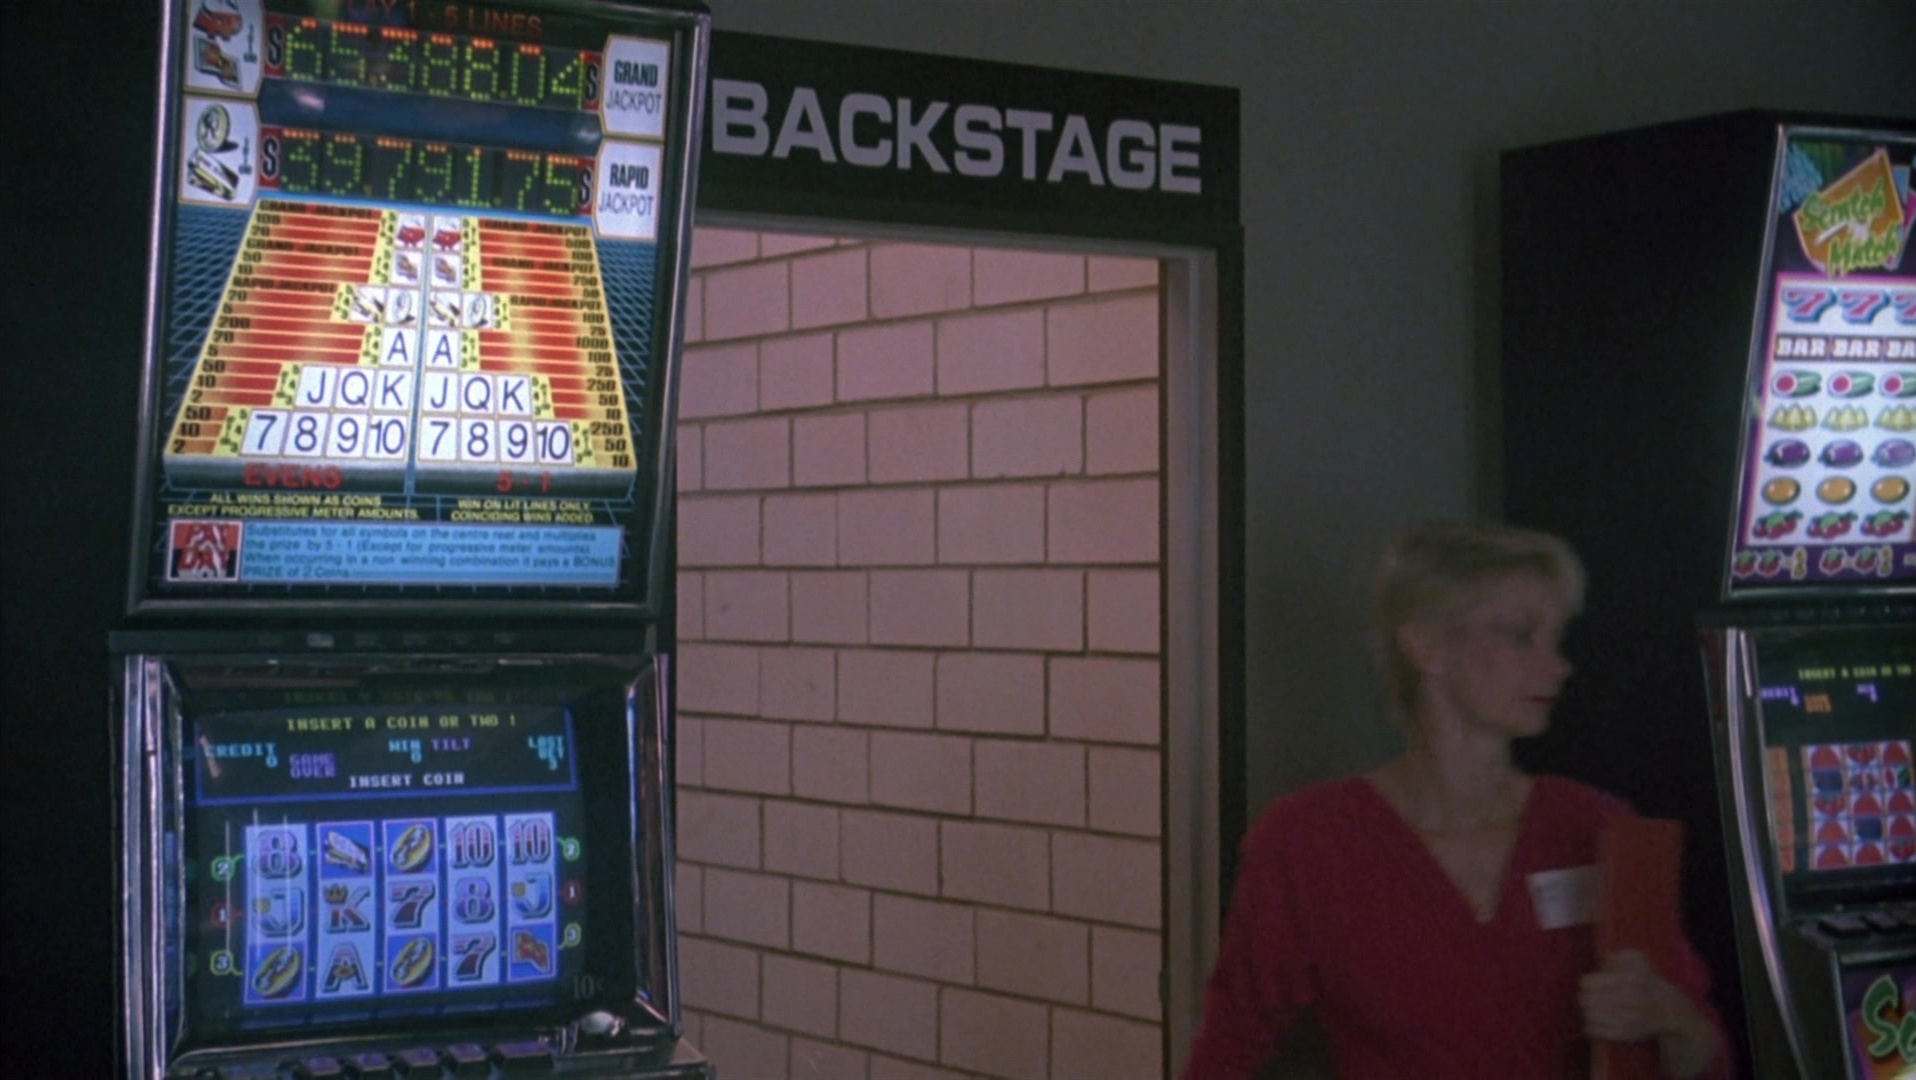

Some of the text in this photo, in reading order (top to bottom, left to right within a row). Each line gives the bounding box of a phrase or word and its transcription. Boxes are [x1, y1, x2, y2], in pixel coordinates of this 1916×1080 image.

[468, 8, 542, 34] LINES
[614, 60, 659, 88] GRAND
[606, 88, 662, 114] JACKPOT
[712, 78, 1201, 194] BACKSTAGE
[609, 163, 649, 189] RAPID
[598, 191, 654, 216] JACKPOT
[386, 331, 408, 362] A
[432, 333, 452, 364] A
[1777, 335, 1827, 357] BAR
[1832, 336, 1882, 358] BAR
[203, 360, 225, 373] 50
[306, 370, 326, 404] J
[341, 371, 369, 406] Q
[382, 374, 405, 406] K
[430, 376, 448, 409] J
[464, 376, 491, 411] Q
[502, 379, 525, 412] K
[598, 393, 619, 406] 50
[185, 407, 212, 420] 50
[180, 423, 200, 437] 10
[255, 414, 277, 450] 7
[294, 415, 317, 451] 8
[336, 417, 359, 453] 9
[370, 419, 406, 455] 10
[590, 422, 624, 437] 250
[173, 439, 186, 453] 2
[430, 421, 449, 456] 7
[467, 421, 488, 457] 8
[507, 423, 528, 459] 9
[536, 425, 569, 460] 10
[604, 438, 627, 452] 50
[612, 454, 630, 468] 10
[243, 462, 342, 488] EVENS
[209, 493, 382, 507] ALL WINS SHOWN AS COINS
[458, 499, 481, 510] WIN
[484, 500, 502, 510] ON
[504, 500, 521, 510] LIT
[524, 500, 557, 511] LINES
[168, 504, 217, 516] EXCEPT
[221, 505, 307, 517] PROGRESSIVE
[312, 506, 354, 518] METER
[451, 511, 520, 522] COINCIDING
[523, 512, 551, 522] WINS
[246, 524, 596, 542] Substitutes for all symbols on the centre reel and multiplies
[269, 539, 300, 550] prize
[306, 540, 321, 552] by
[406, 542, 422, 552] for
[428, 543, 496, 554] progressive
[499, 544, 532, 553] meter
[244, 553, 280, 563] When
[284, 554, 342, 565] occurring
[372, 556, 395, 564] non
[401, 556, 446, 567] winning
[449, 556, 520, 567] combination
[532, 558, 560, 568] pays
[573, 557, 615, 568] BONUS
[244, 566, 282, 577] PRIZE
[287, 567, 300, 577] of
[286, 714, 499, 731] INSERT A COIN OR TWO
[204, 742, 276, 758] CREDIT
[431, 738, 471, 751] TILT
[290, 765, 336, 777] OVER
[350, 772, 465, 788] INSERT COIN
[255, 830, 303, 879] 8
[451, 821, 495, 869] 10
[509, 818, 551, 866] 10
[325, 884, 371, 934] K
[390, 880, 436, 929] 7
[455, 876, 495, 925] 8
[323, 943, 369, 993] A
[450, 932, 497, 982] 7
